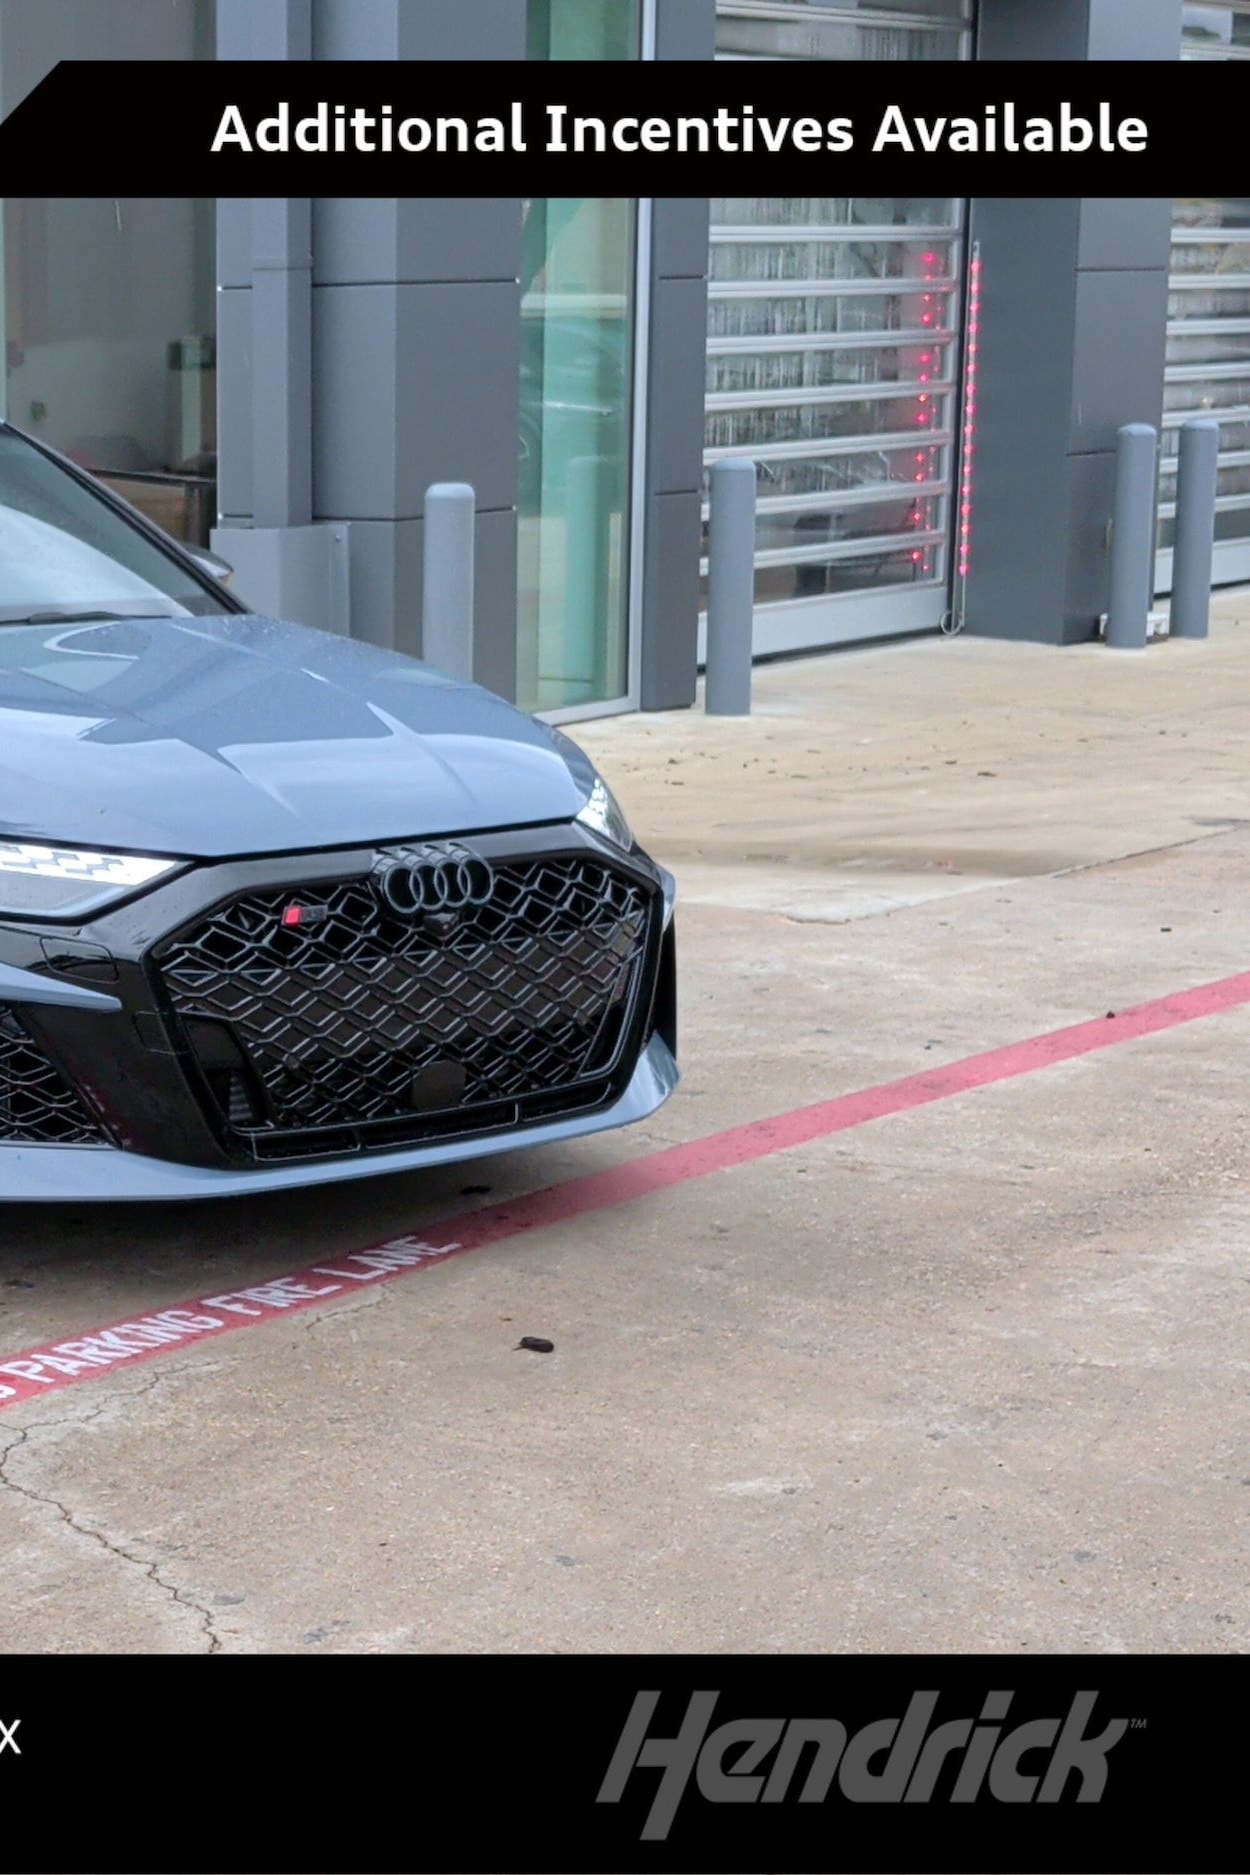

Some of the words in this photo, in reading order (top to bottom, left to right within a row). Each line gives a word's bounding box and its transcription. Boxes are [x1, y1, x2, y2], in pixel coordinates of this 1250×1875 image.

[1, 1310, 225, 1383] PARKING
[200, 1276, 342, 1317] FIRE
[312, 1235, 462, 1281] LANE
